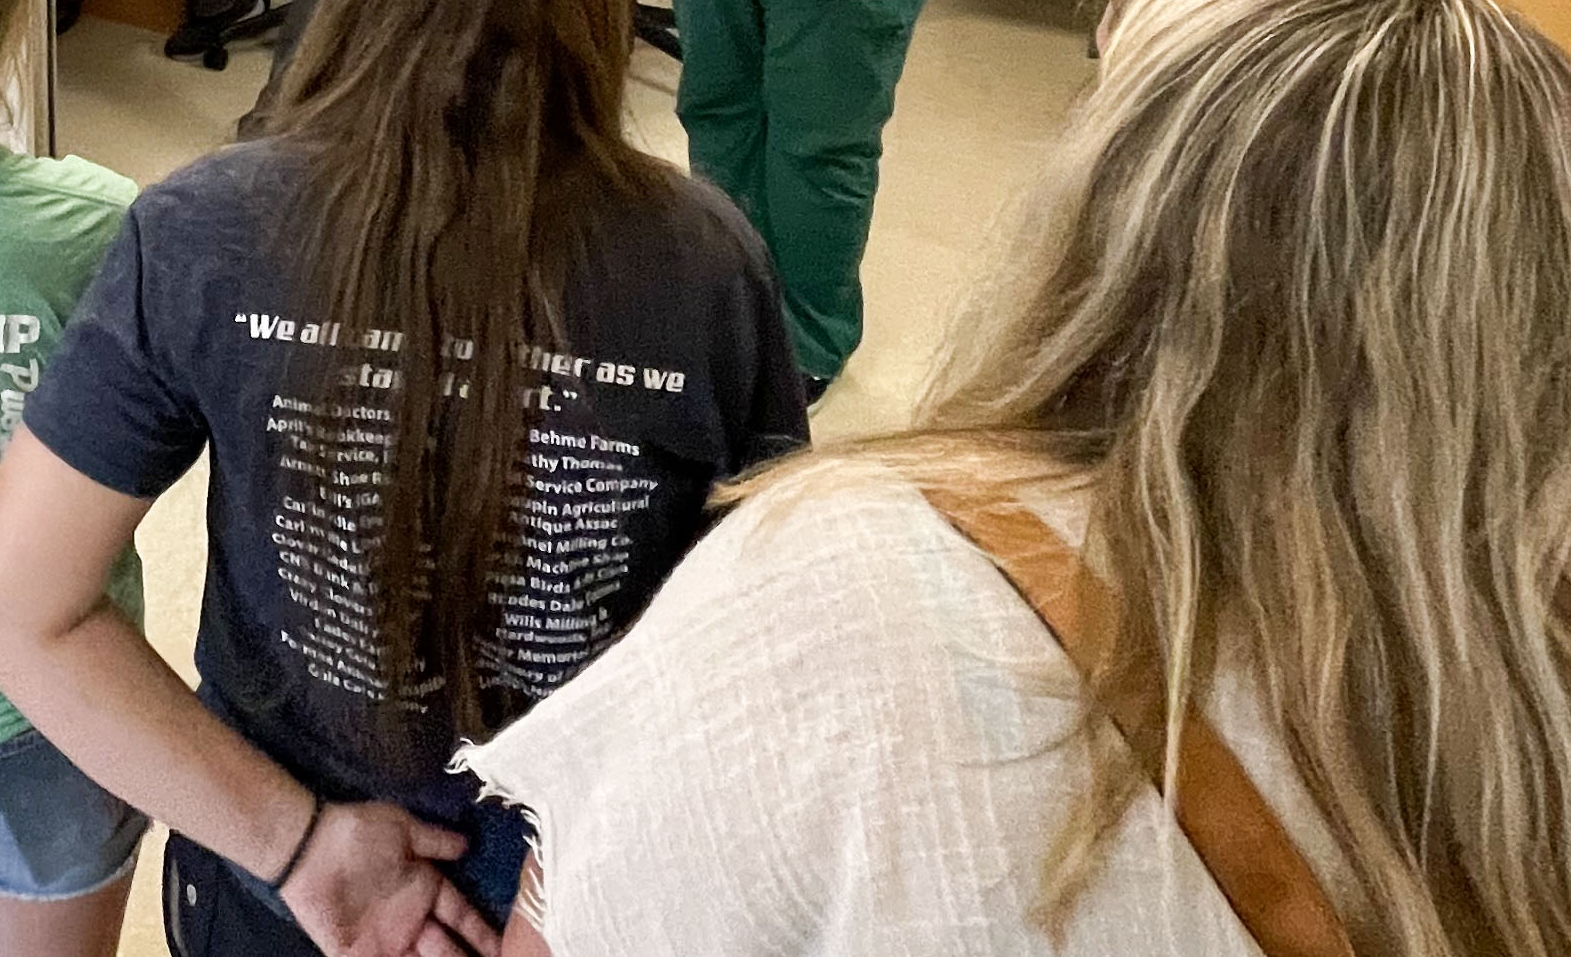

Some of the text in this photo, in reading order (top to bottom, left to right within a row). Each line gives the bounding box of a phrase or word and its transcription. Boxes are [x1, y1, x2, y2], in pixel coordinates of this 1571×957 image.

[299, 321, 340, 347] all
[594, 361, 637, 387] as
[641, 367, 686, 394] we
[529, 428, 641, 457] Behme Farms
